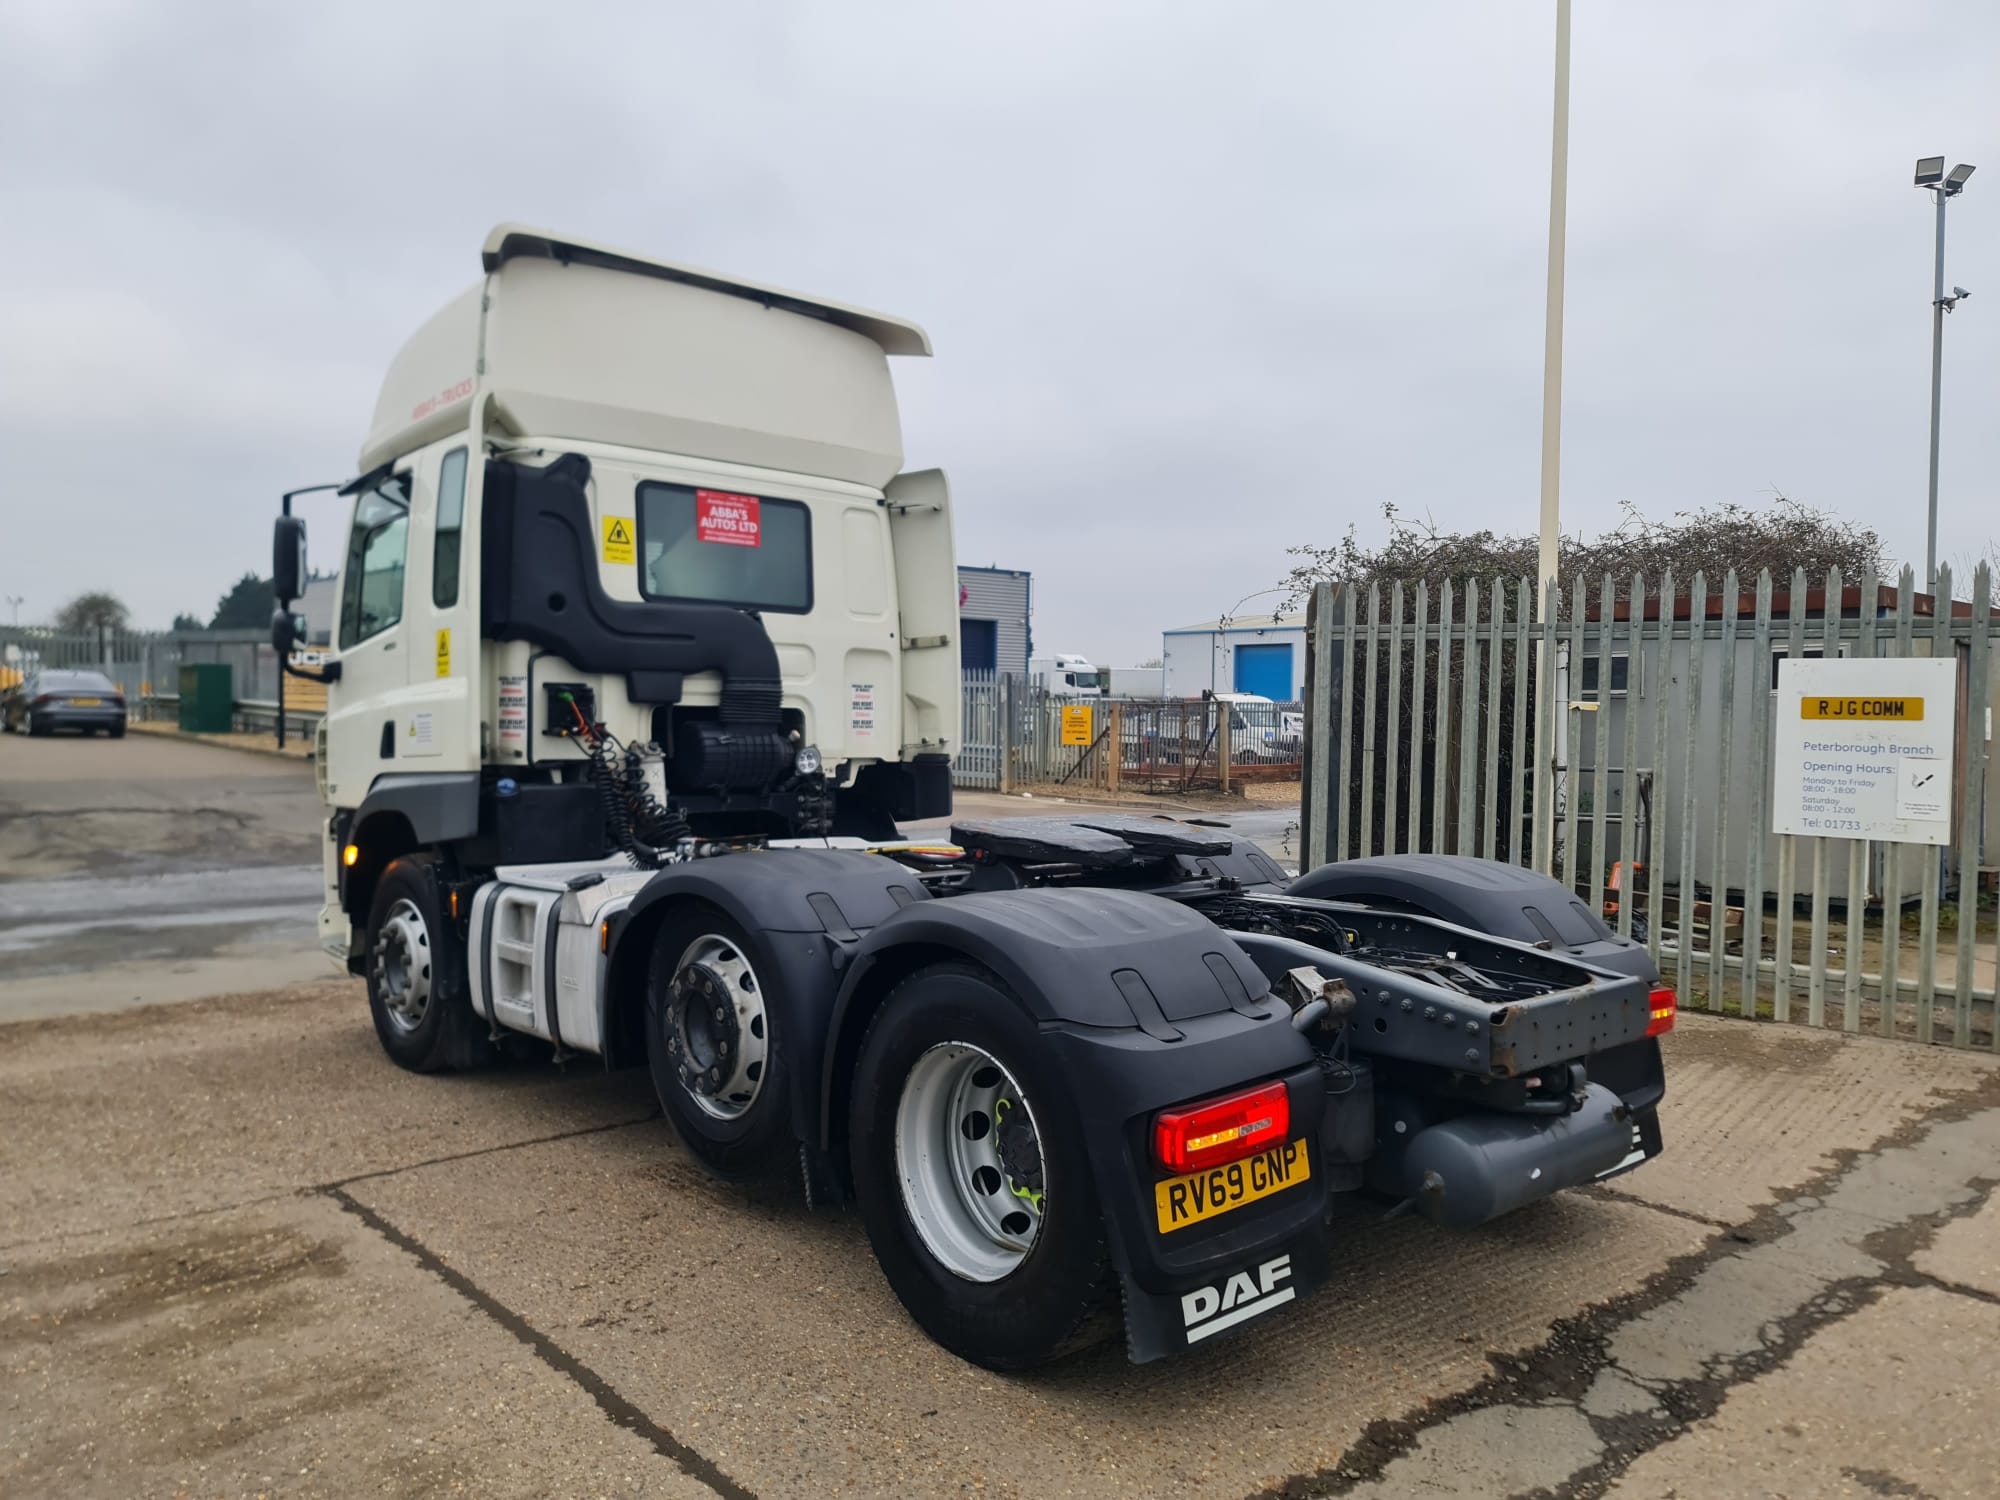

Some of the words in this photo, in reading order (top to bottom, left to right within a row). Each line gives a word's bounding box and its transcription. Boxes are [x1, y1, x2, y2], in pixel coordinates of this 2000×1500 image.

[710, 505, 749, 521] ABBA'S
[700, 516, 737, 531] AUTOS
[738, 521, 758, 533] LTD
[1862, 700, 1904, 716] COMM
[1803, 741, 1886, 755] Peterborough
[1889, 744, 1934, 755] Branch
[1803, 761, 1853, 774] Opening
[1856, 763, 1896, 774] Hours:
[1802, 777, 1836, 786] Monday
[1849, 779, 1875, 788] Friday
[1802, 785, 1825, 793] 08:00
[1833, 786, 1856, 794] 18:00
[1802, 796, 1841, 806] Saturday
[1802, 804, 1824, 812] 08:00
[1833, 806, 1856, 814] 12:00
[1801, 817, 1822, 828] Tel:
[1824, 819, 1861, 831] 01733
[1168, 1164, 1245, 1223] RV69
[1250, 1144, 1298, 1192] GNP
[1181, 1254, 1293, 1327] DAF
